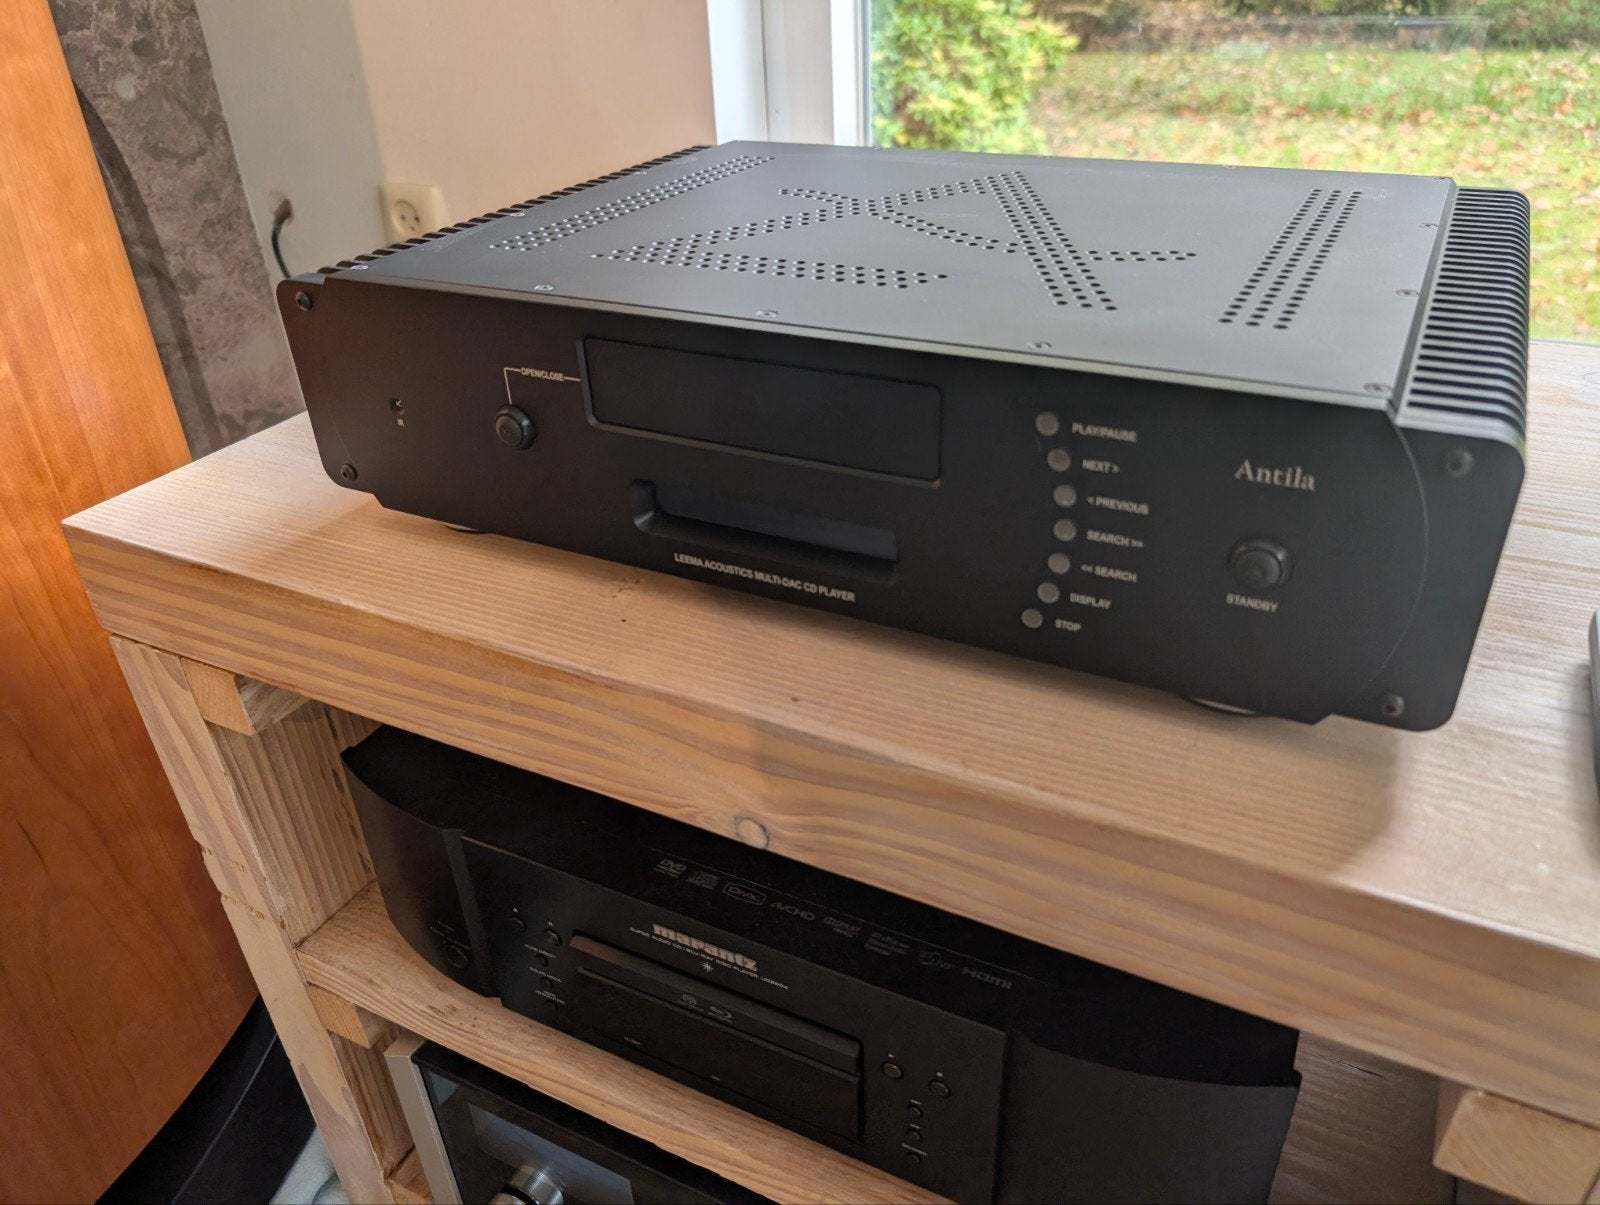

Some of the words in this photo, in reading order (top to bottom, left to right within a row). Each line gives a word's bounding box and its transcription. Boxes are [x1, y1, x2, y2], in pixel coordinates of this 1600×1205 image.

[521, 367, 564, 381] OPEN/CLOSE
[1071, 422, 1138, 443] PLAY/PAUSE
[1082, 459, 1111, 473] NEXT
[1234, 459, 1316, 493] Antila
[1095, 496, 1149, 515] PREVIOUS
[1086, 529, 1129, 547] SEARCH
[674, 552, 703, 568] LEEMA
[704, 561, 753, 579] ACOUSTICS
[754, 570, 802, 590] MULTI-DAC
[803, 583, 817, 594] CD
[818, 586, 856, 603] PLAYER
[1094, 565, 1138, 583] SEARCH
[1069, 592, 1111, 609] DISPLAY
[1226, 593, 1279, 613] STANDBY
[1054, 618, 1082, 632] STOP
[659, 858, 687, 872] DVD
[769, 901, 816, 921] AVCHD
[652, 923, 759, 973] marantz
